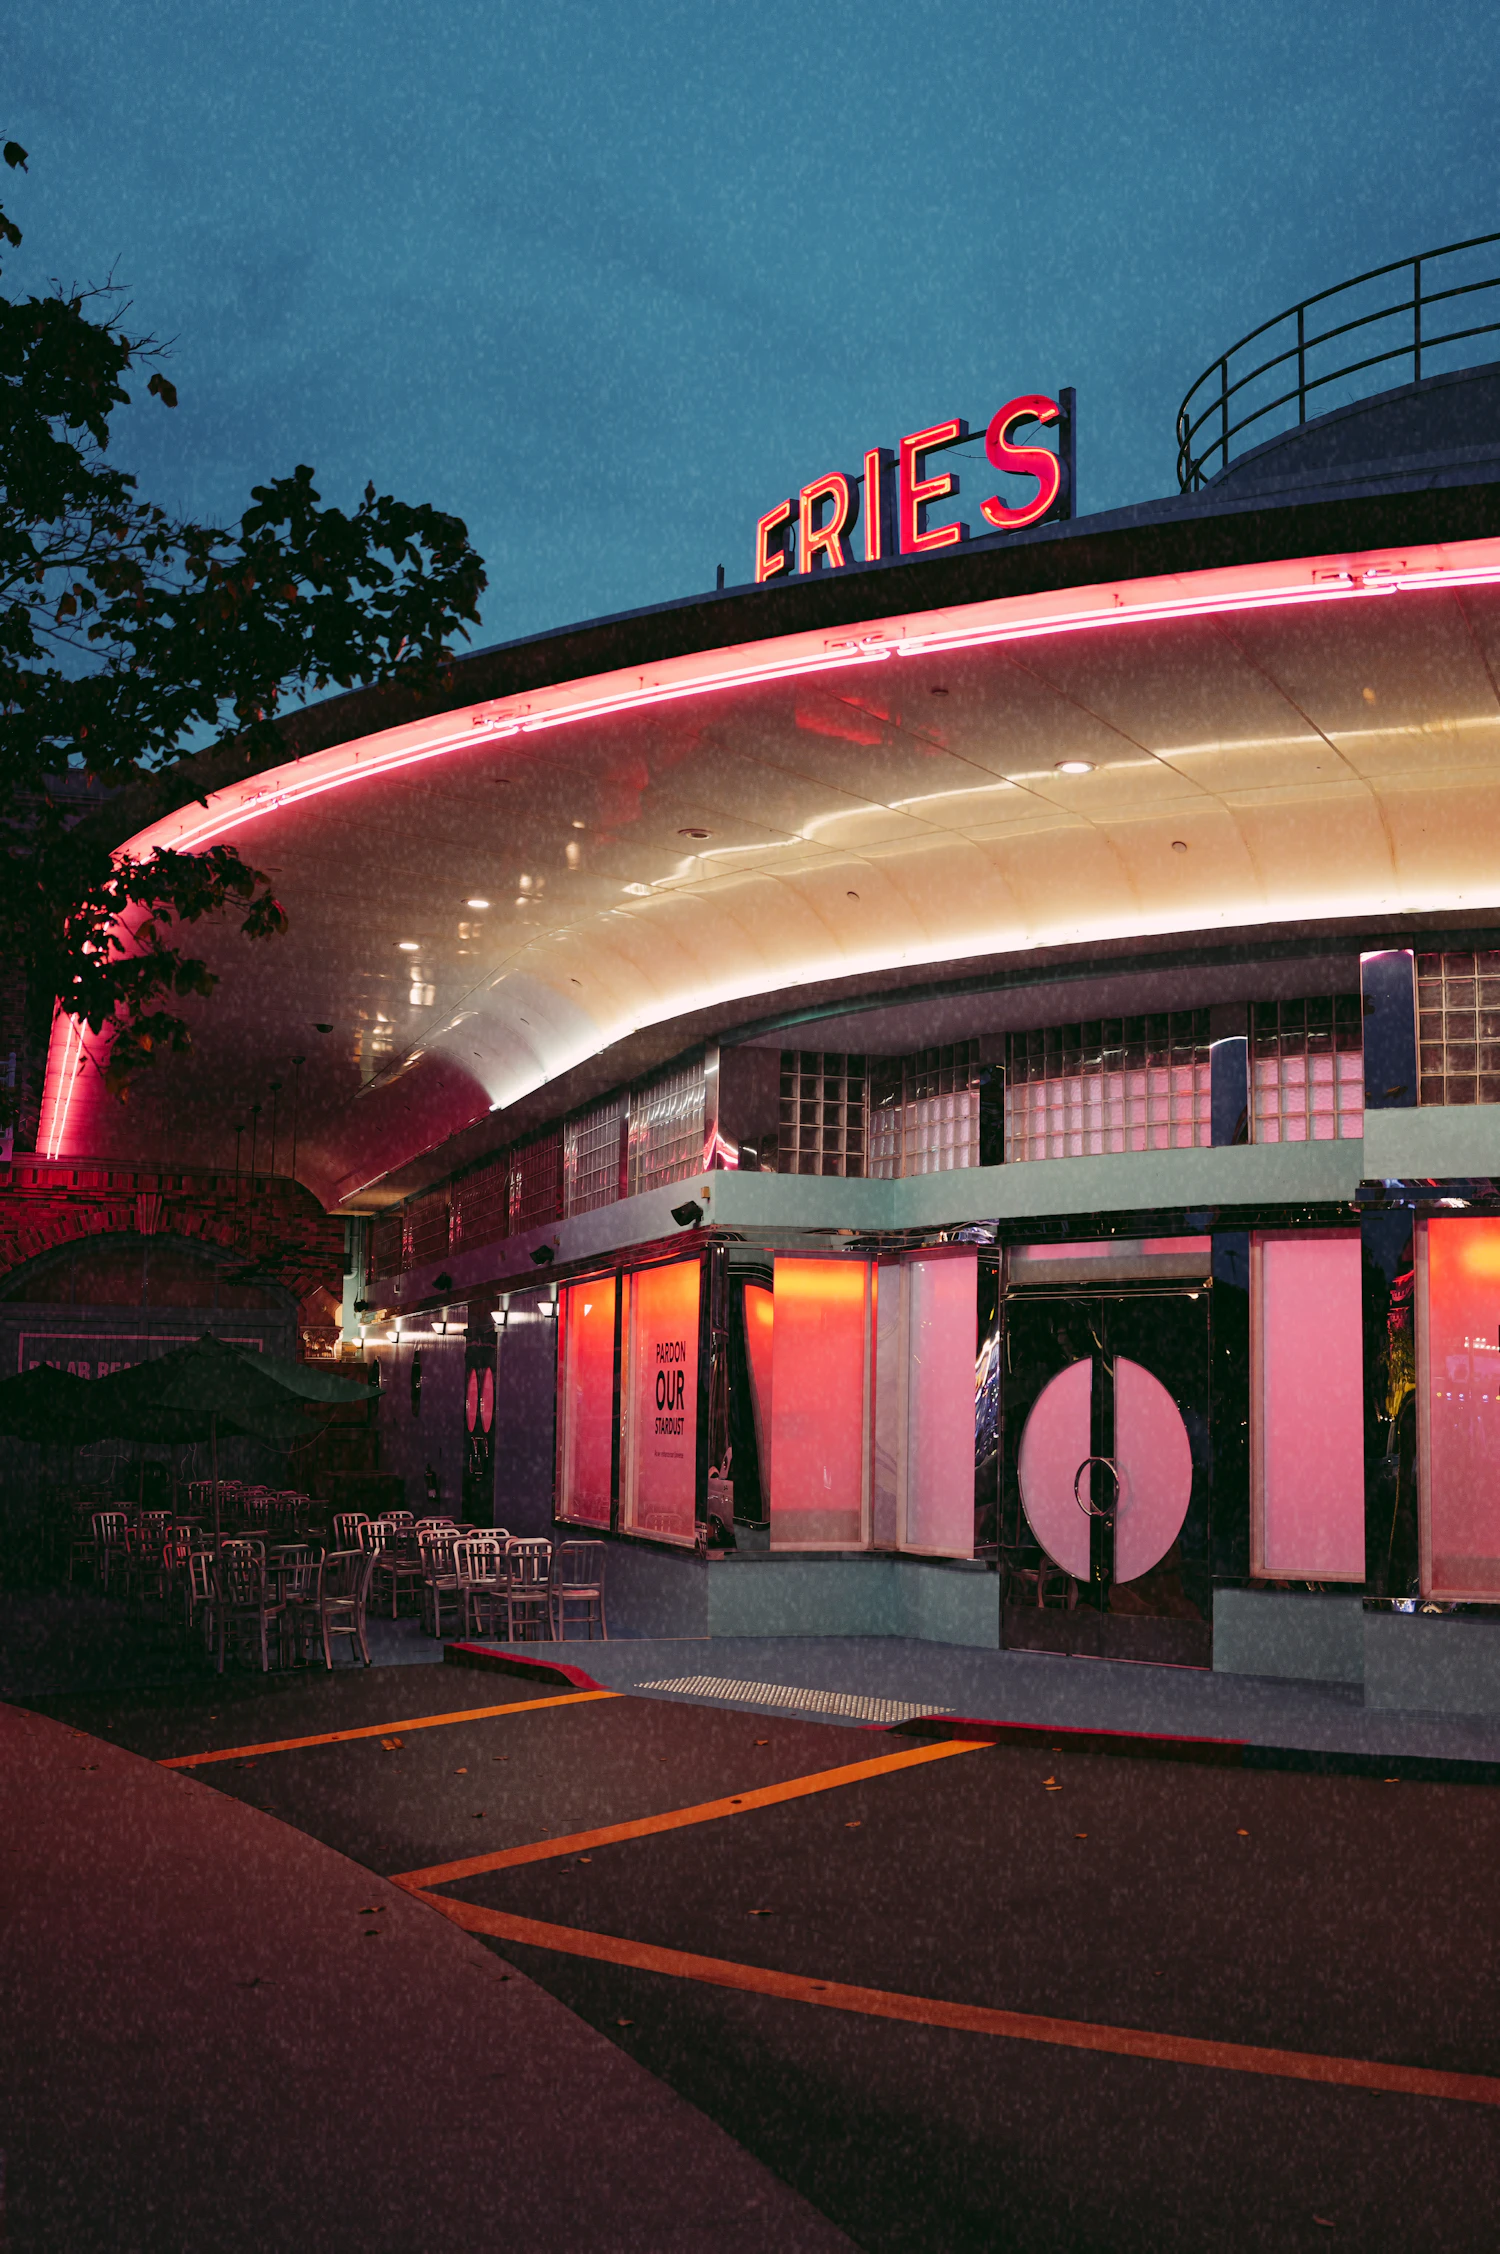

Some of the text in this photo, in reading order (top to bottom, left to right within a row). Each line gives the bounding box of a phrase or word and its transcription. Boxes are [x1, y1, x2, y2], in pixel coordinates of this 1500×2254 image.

[755, 394, 1062, 583] FRIES
[656, 1341, 686, 1363] PARDON
[97, 1361, 142, 1379] BE
[656, 1370, 685, 1411] OUR
[655, 1417, 684, 1435] STARDUST
